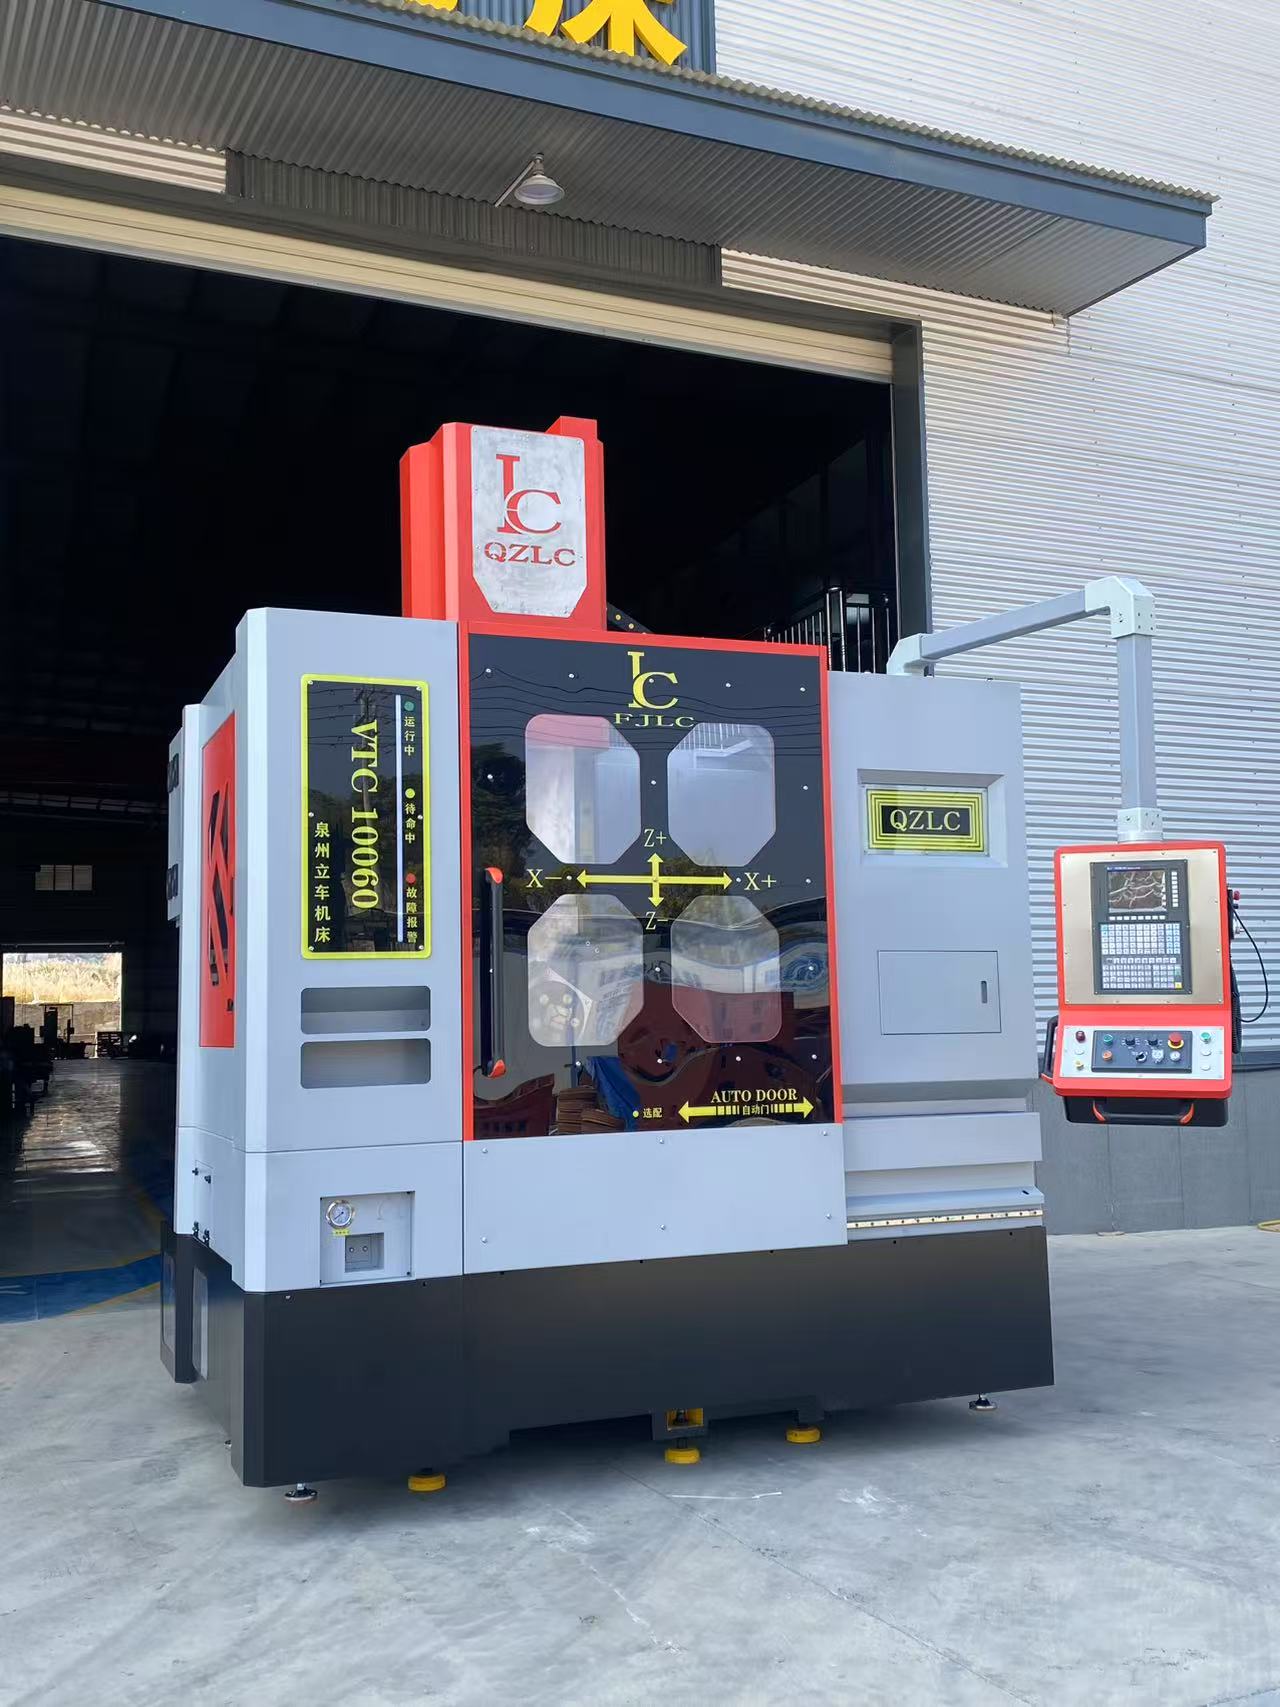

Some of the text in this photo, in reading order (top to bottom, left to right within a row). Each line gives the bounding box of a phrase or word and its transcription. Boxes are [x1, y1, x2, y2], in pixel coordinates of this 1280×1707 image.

[484, 541, 576, 567] QZLC
[404, 715, 416, 756] 运行中
[351, 719, 379, 910] VTC 10060
[890, 809, 961, 832] QZLC
[643, 828, 668, 848] Z+
[314, 821, 332, 944] 泉州立车机床
[744, 872, 777, 891] X+
[406, 887, 419, 944] 故障报警
[710, 1088, 798, 1103] AUTO DOOR
[642, 1107, 663, 1119] 选配
[742, 1104, 769, 1116] 自动门
